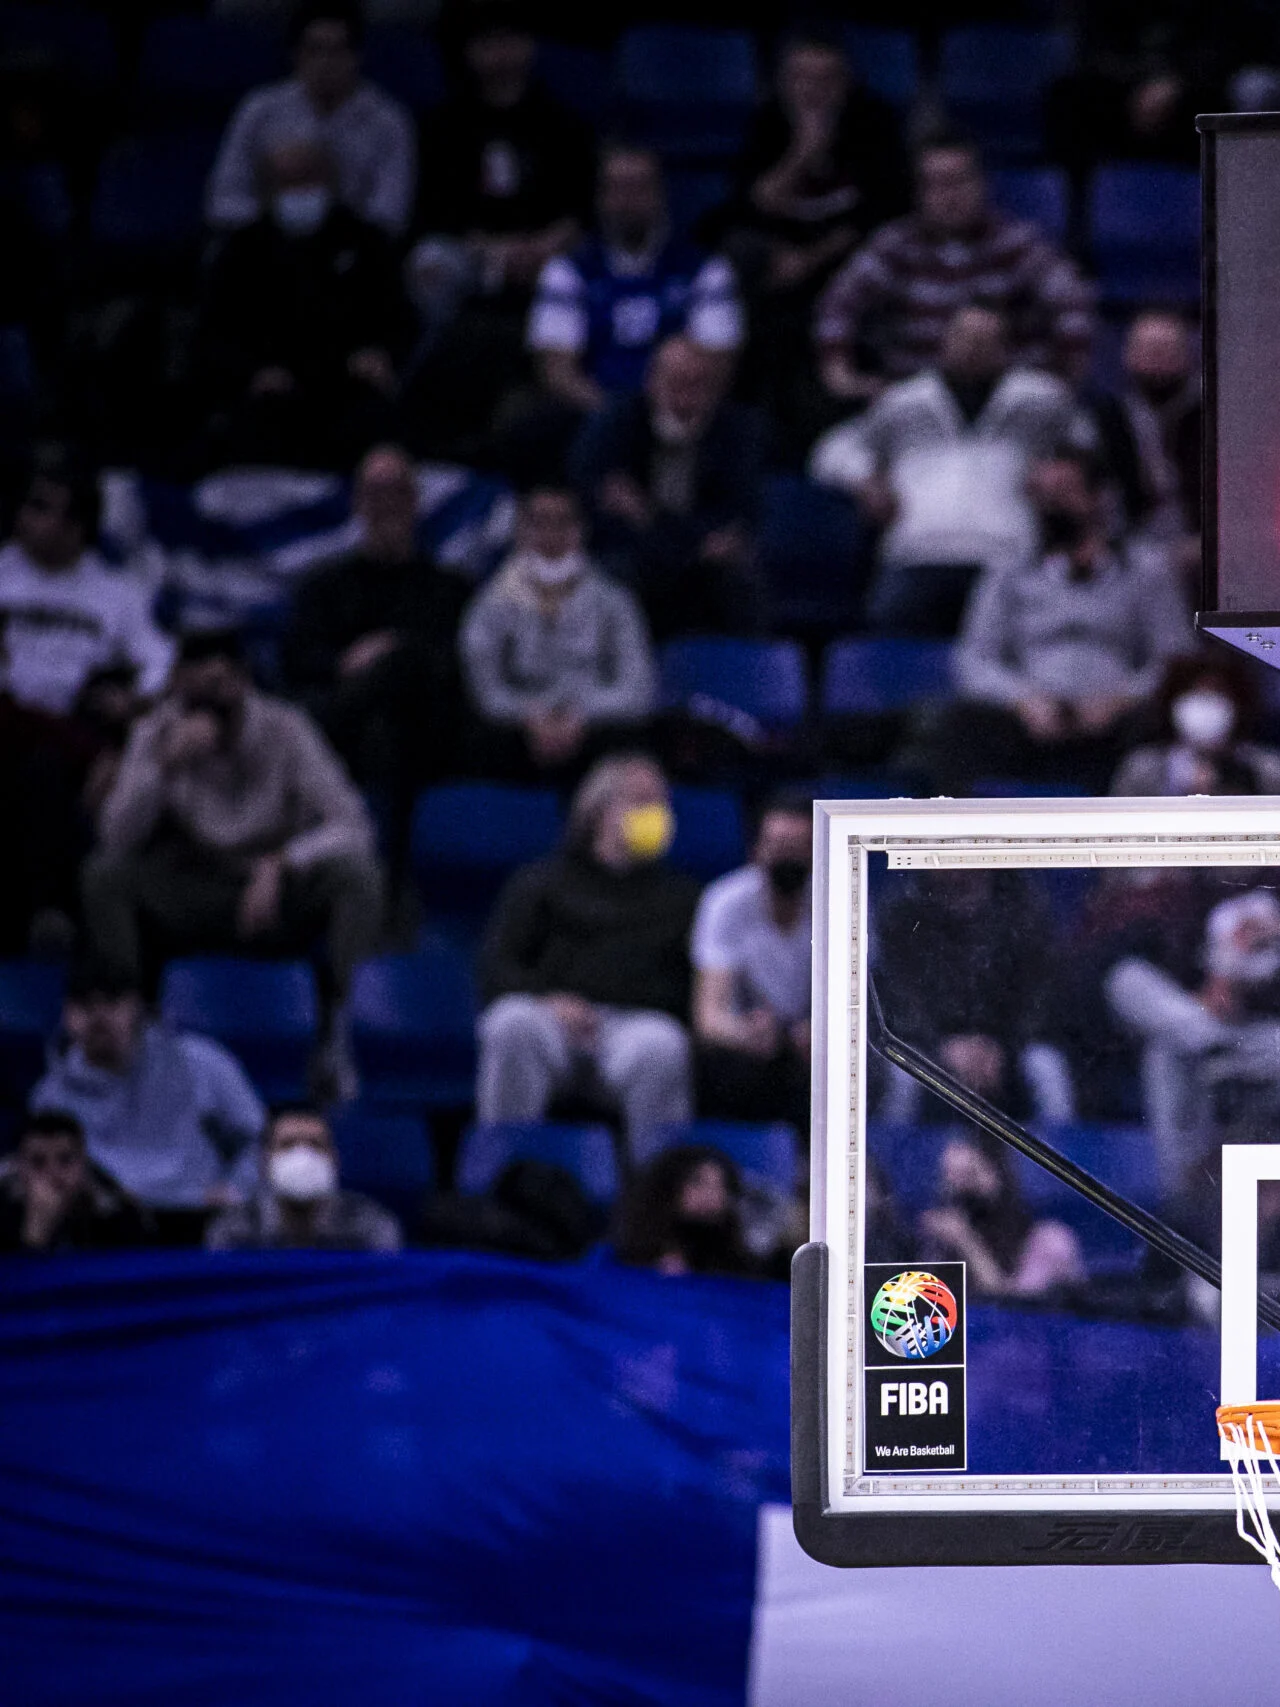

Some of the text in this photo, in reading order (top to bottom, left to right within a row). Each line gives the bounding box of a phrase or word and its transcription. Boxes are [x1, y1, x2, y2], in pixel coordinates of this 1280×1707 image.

[880, 1381, 949, 1416] FIBA
[875, 1444, 955, 1457] We Are Basketball
